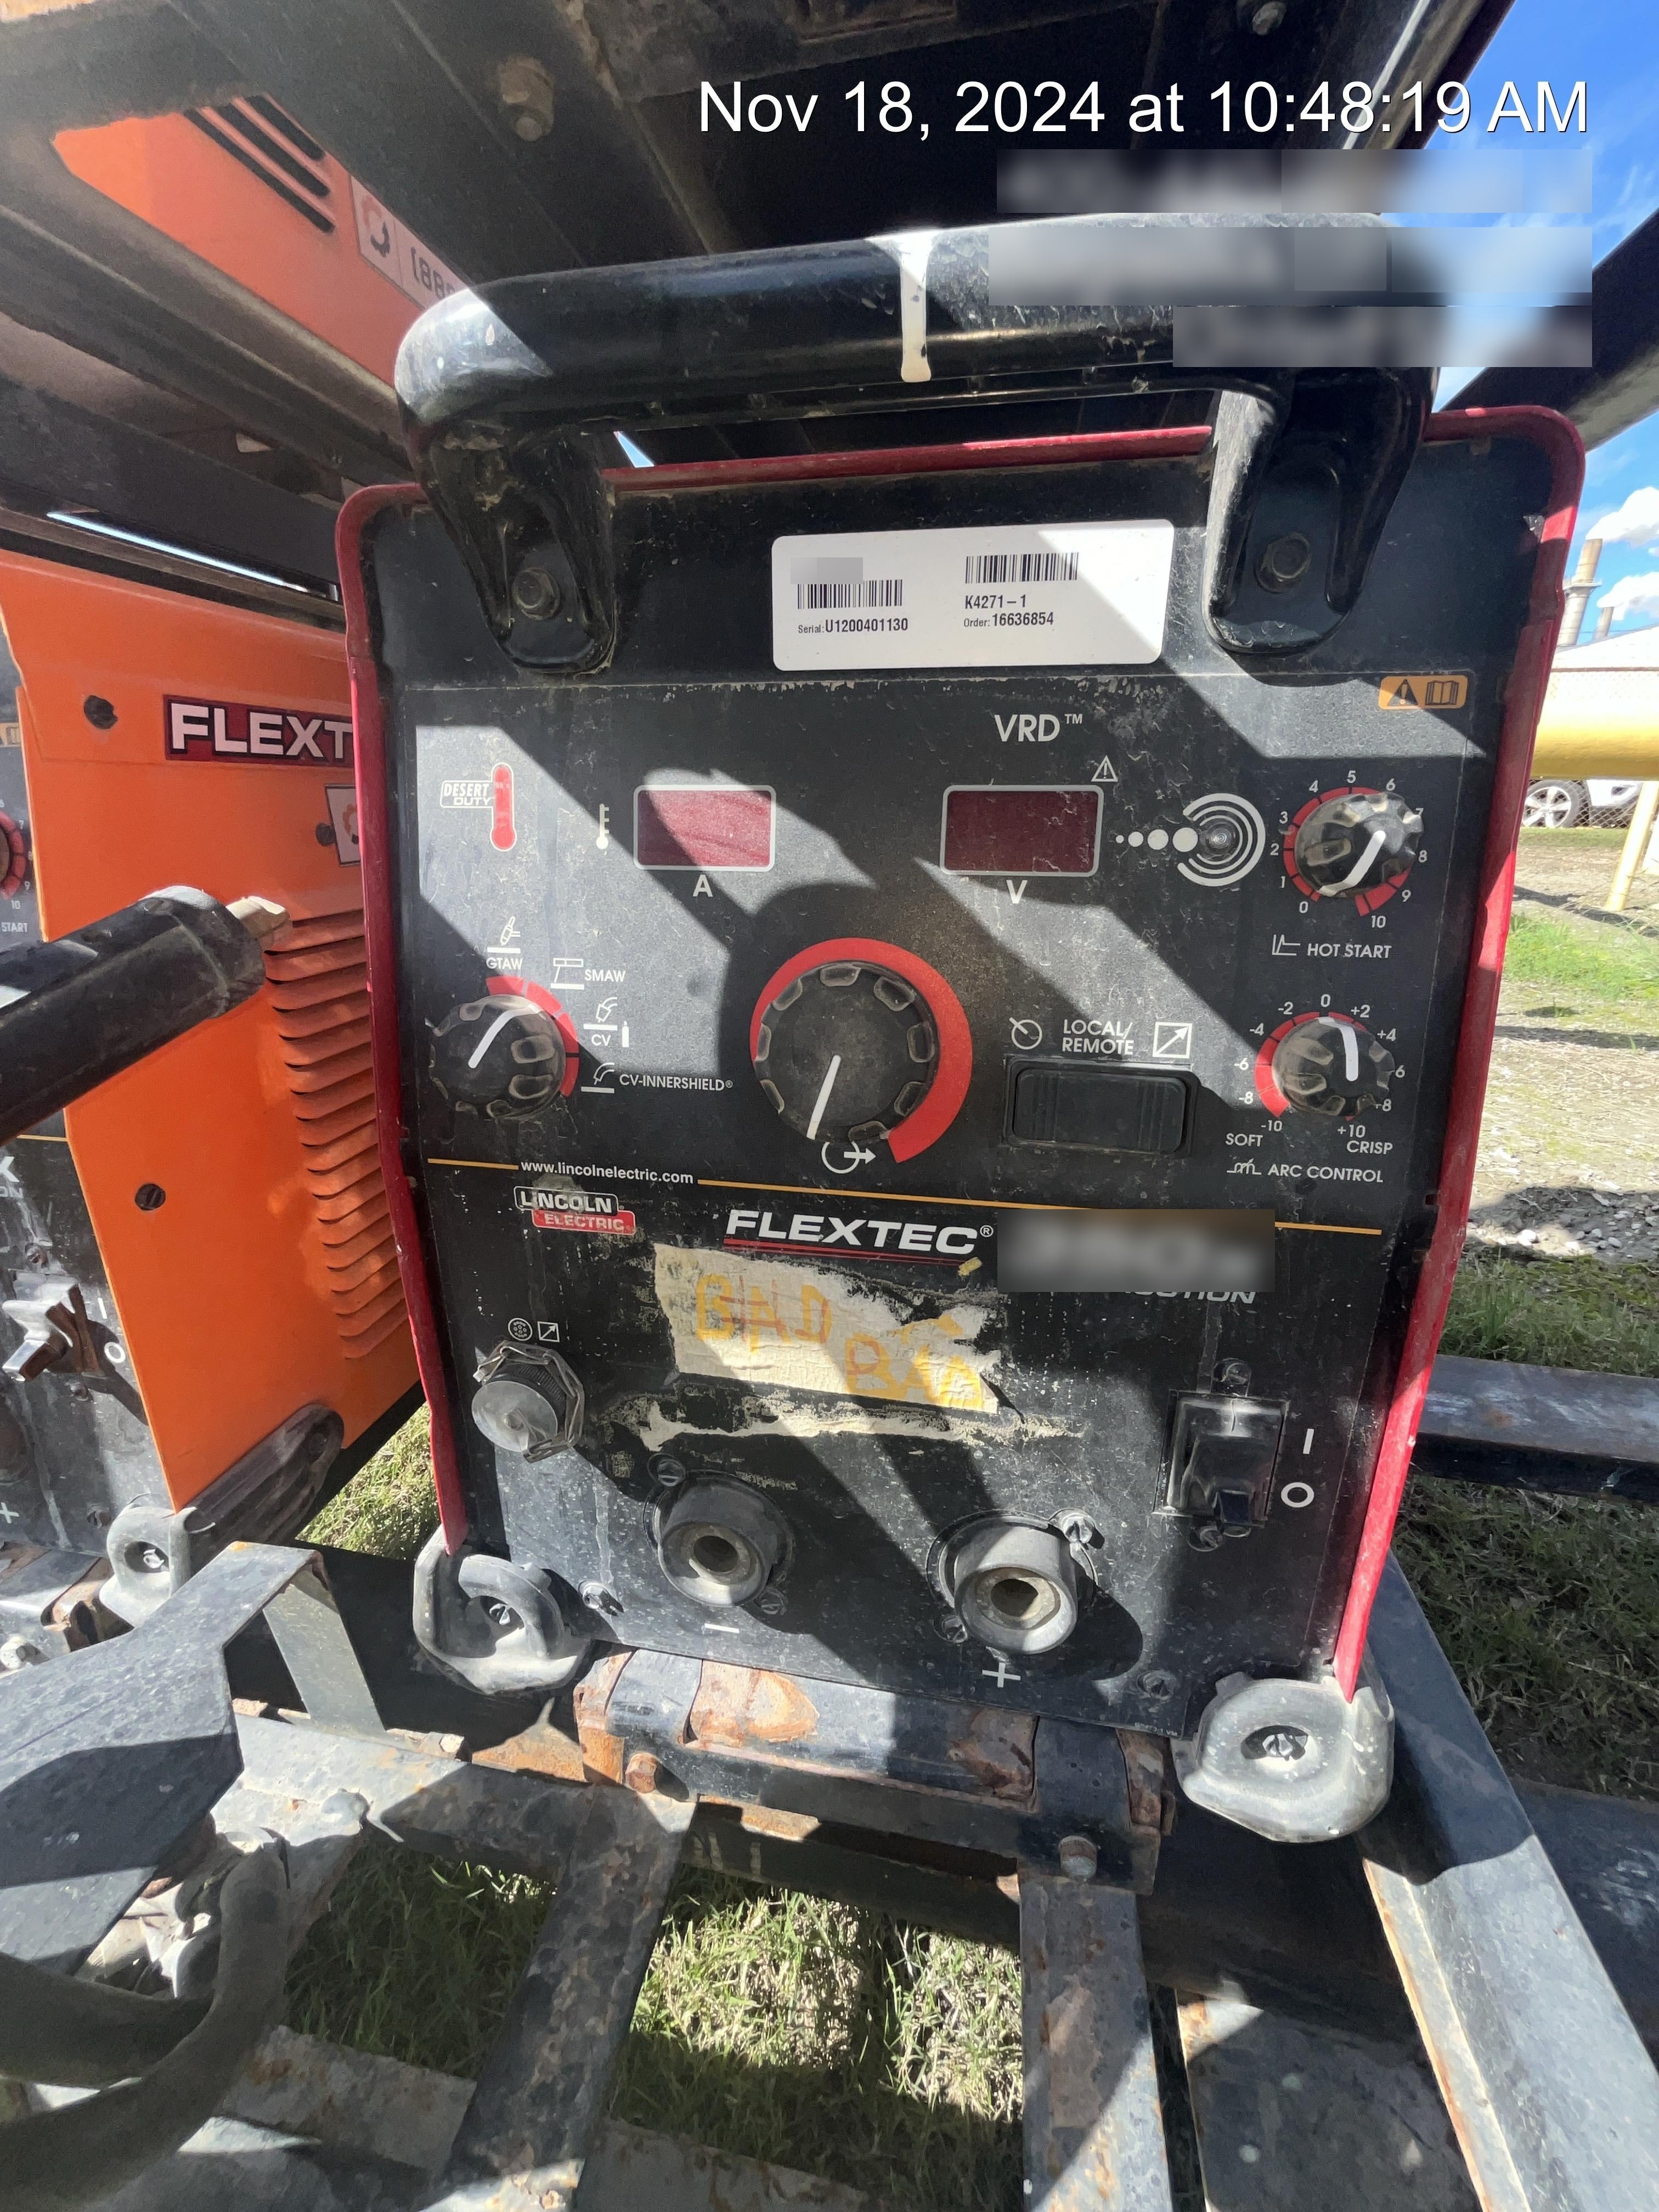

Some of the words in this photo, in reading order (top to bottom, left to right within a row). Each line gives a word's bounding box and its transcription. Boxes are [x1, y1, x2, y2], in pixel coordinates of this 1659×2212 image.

[825, 618, 909, 633] U1200401130
[964, 617, 990, 629] Order:
[992, 611, 1054, 627] 16636854
[1346, 770, 1356, 784] 5
[443, 783, 490, 797] DESERT
[1308, 780, 1319, 793] 4
[1386, 778, 1396, 792] 6
[453, 797, 492, 806] DUTY
[1279, 811, 1288, 824] 3
[1269, 843, 1279, 856] 2
[1418, 850, 1427, 863] 8
[693, 874, 713, 898] A
[1281, 876, 1286, 889] 1
[1006, 879, 1028, 904] V
[1401, 889, 1412, 902] 9
[1299, 901, 1309, 914] 0
[1371, 915, 1387, 928] 10
[1307, 943, 1340, 957] HOT
[1344, 944, 1392, 958] START
[486, 957, 523, 970] GTAW
[584, 969, 626, 983] SMAW
[1278, 1001, 1294, 1015] -2
[1321, 994, 1331, 1008] 0
[1351, 1005, 1370, 1018] +2
[1063, 1019, 1133, 1039] LOCAL/
[1249, 1023, 1264, 1036] -4
[1377, 1028, 1396, 1042] +4
[591, 1034, 611, 1046] CV
[1062, 1037, 1134, 1056] REMOTE
[1234, 1058, 1249, 1071] -6
[1239, 1091, 1254, 1105] -8
[1261, 1120, 1283, 1132] -10
[1337, 1124, 1365, 1138] +10
[1226, 1133, 1263, 1147] SOFT
[1346, 1140, 1393, 1155] CRISP
[521, 1161, 693, 1185] www.lincolnelectric.com
[1267, 1164, 1302, 1178] ARC
[1307, 1166, 1384, 1183] CONTROL
[521, 1190, 612, 1214] LINCOLN
[544, 1212, 625, 1231] ELECTRIC
